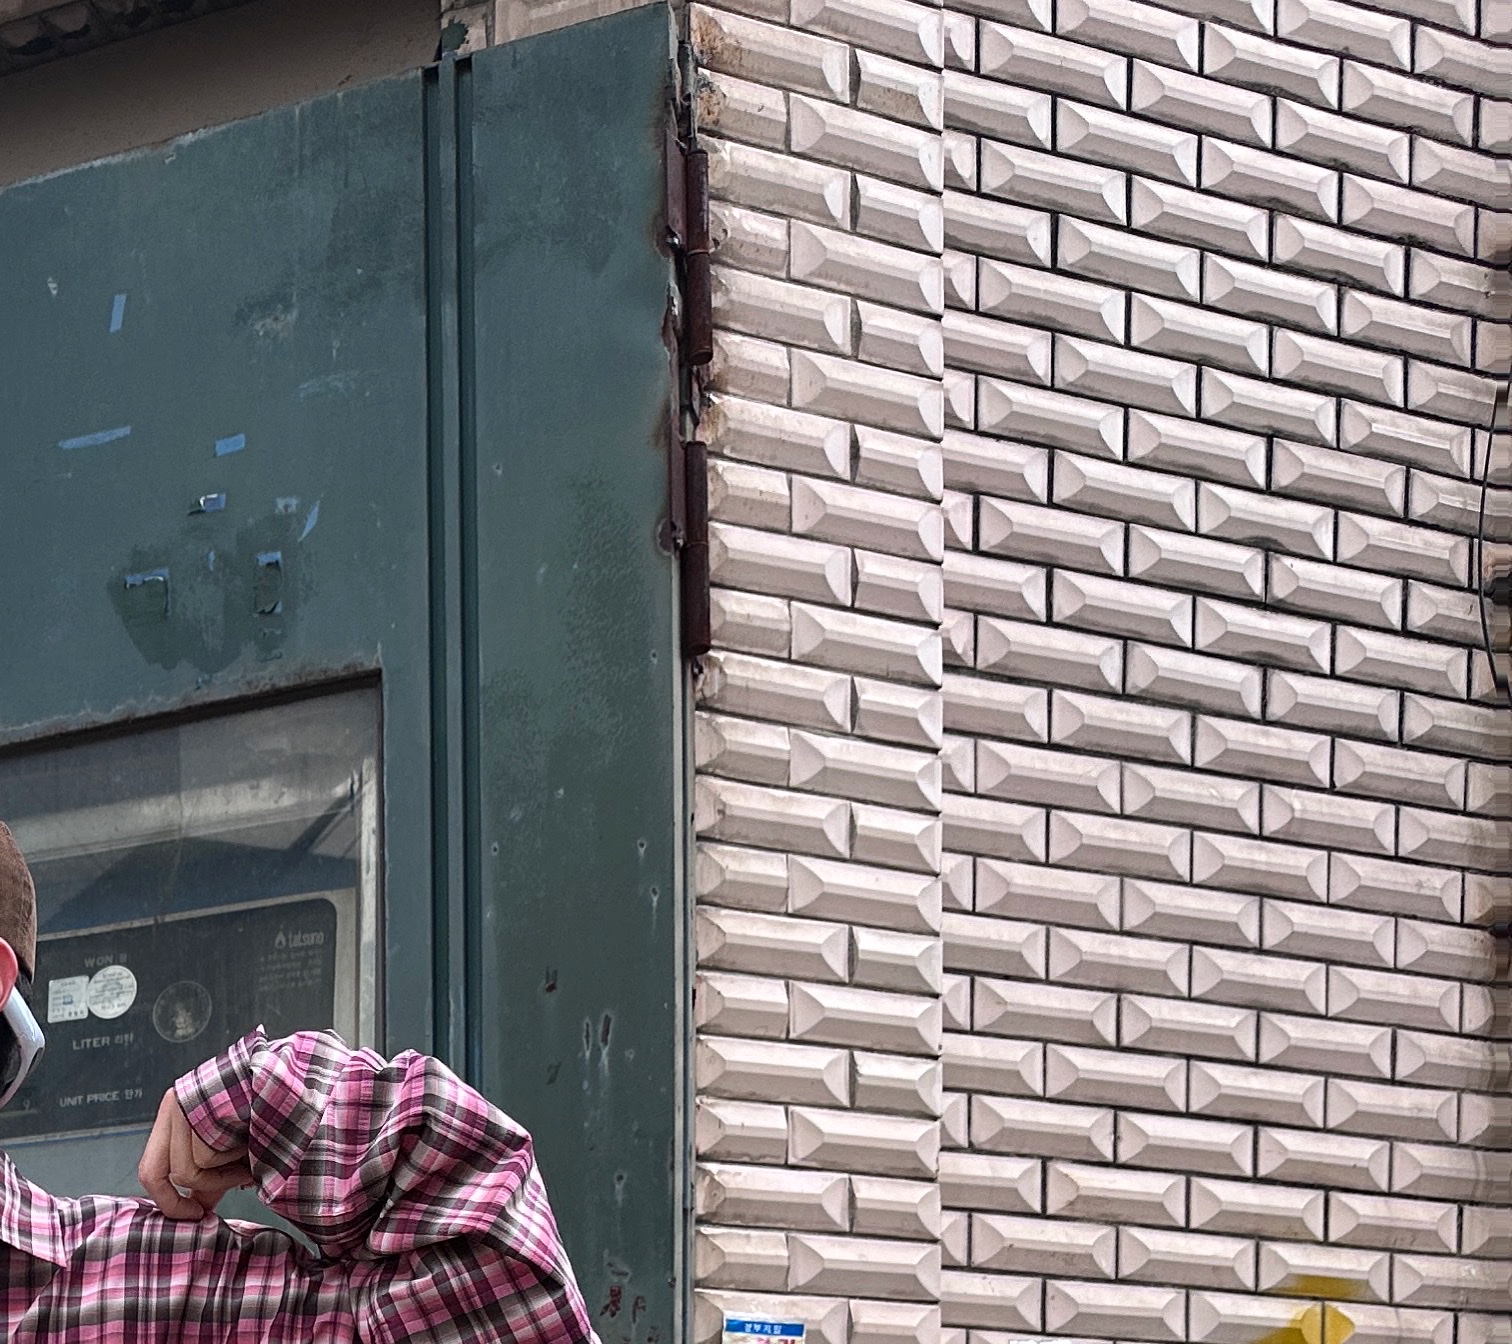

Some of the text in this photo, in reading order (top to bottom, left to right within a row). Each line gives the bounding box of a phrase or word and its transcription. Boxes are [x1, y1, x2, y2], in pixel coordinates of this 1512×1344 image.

[72, 1036, 110, 1050] LITER
[59, 1095, 83, 1107] UNIT
[86, 1090, 120, 1104] PRICE
